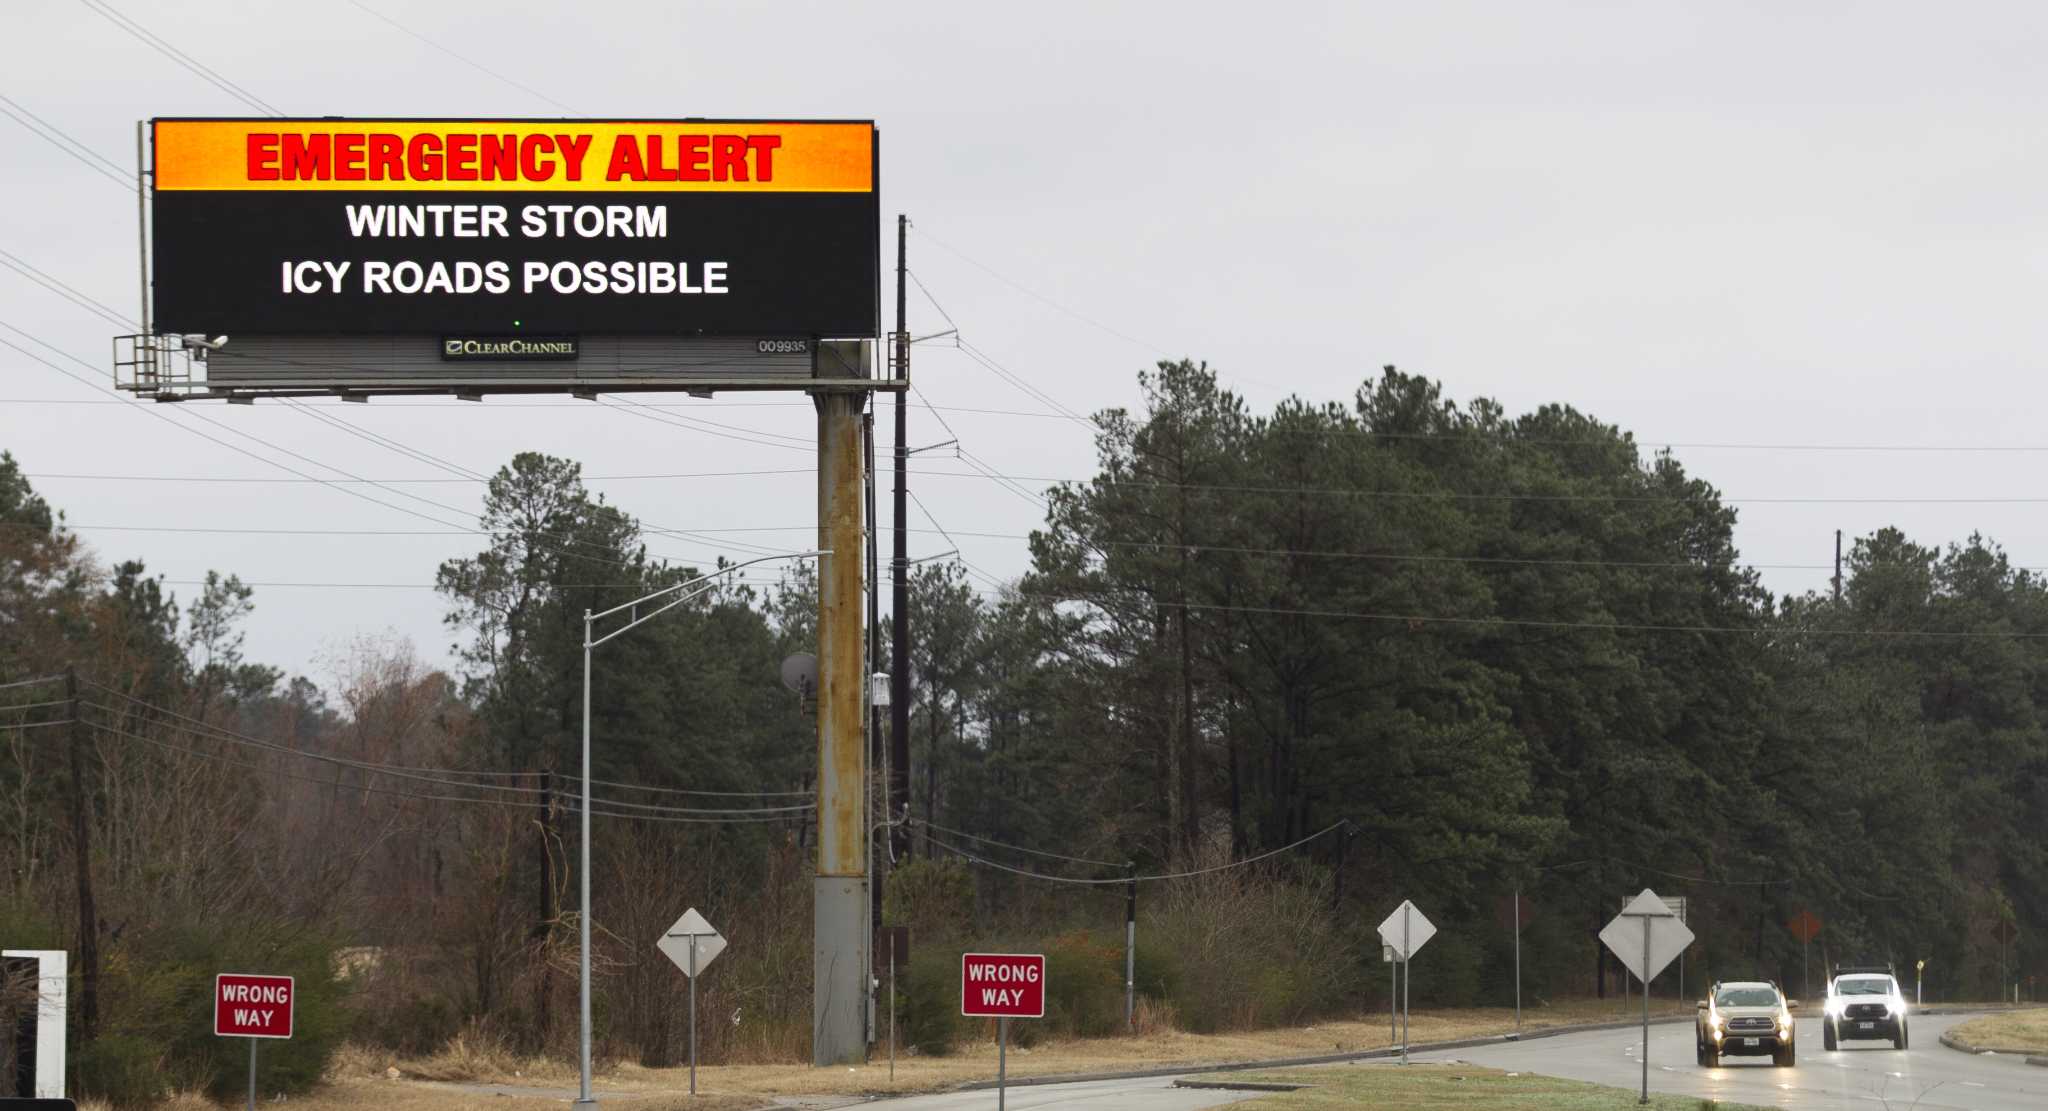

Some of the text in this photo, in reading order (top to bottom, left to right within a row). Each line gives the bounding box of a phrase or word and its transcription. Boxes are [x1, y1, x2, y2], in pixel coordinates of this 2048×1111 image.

[247, 133, 781, 182] EMERGENCY ALERT
[345, 204, 668, 238] WINTER STORM
[282, 260, 729, 294] ICY ROADS POSSIBLE
[759, 340, 806, 353] 009935
[968, 963, 1039, 983] WRONG
[222, 984, 288, 1004] WRONG
[981, 988, 1025, 1007] WAY
[234, 1008, 274, 1027] WAY
